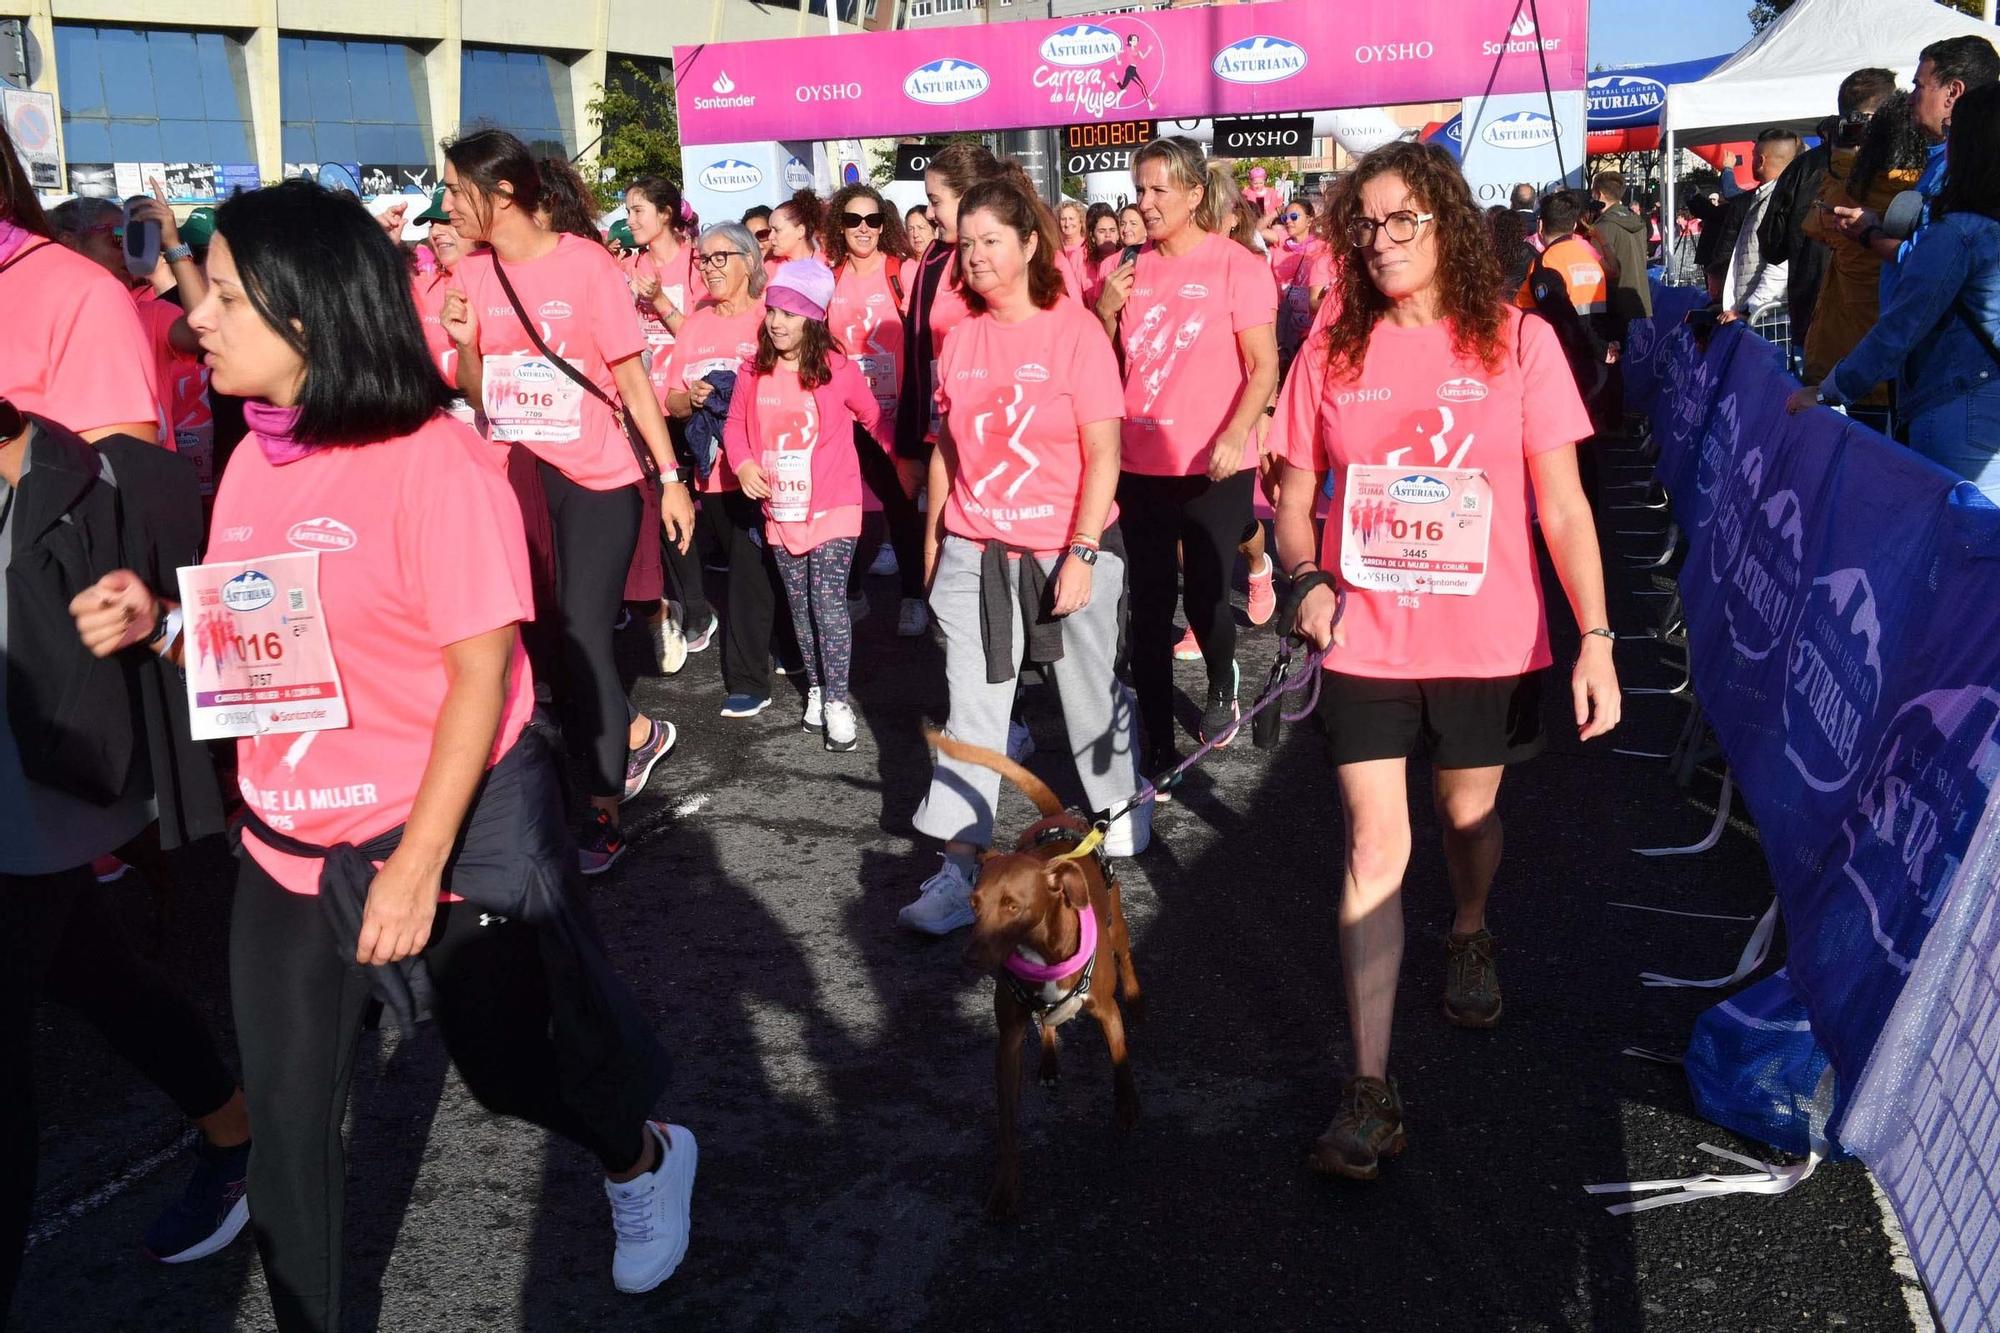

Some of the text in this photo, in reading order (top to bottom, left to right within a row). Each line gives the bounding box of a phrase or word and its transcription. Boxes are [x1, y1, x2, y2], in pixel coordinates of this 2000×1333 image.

[1046, 41, 1117, 58] ASTURIANA
[1355, 41, 1434, 63] OYSHO
[1482, 37, 1560, 56] Santander
[1219, 55, 1299, 74] ASTURIANA
[1033, 65, 1103, 88] Carrera
[796, 83, 862, 102] OYSHO
[911, 77, 983, 95] ASTURIANA
[1588, 88, 1619, 97] ENTRAL
[694, 95, 756, 110] Santander
[1050, 81, 1127, 118] de la Mujer
[1587, 91, 1659, 111] STURIANA
[1070, 121, 1149, 148] 00:08:02
[1228, 130, 1299, 147] OYSHO
[1068, 151, 1131, 174] OYSH
[704, 171, 759, 185] ASTURIANA
[516, 391, 554, 408] 016
[1337, 387, 1391, 405] OYSHO
[778, 480, 807, 492] 016
[1358, 487, 1385, 497] SUMA
[1393, 484, 1446, 498] ASTURIANA
[1390, 519, 1444, 541] 016
[1402, 548, 1428, 559] 3445
[1426, 577, 1468, 588] Santander
[236, 631, 284, 662] 016
[283, 789, 305, 811] LA
[310, 783, 378, 810] MUJER
